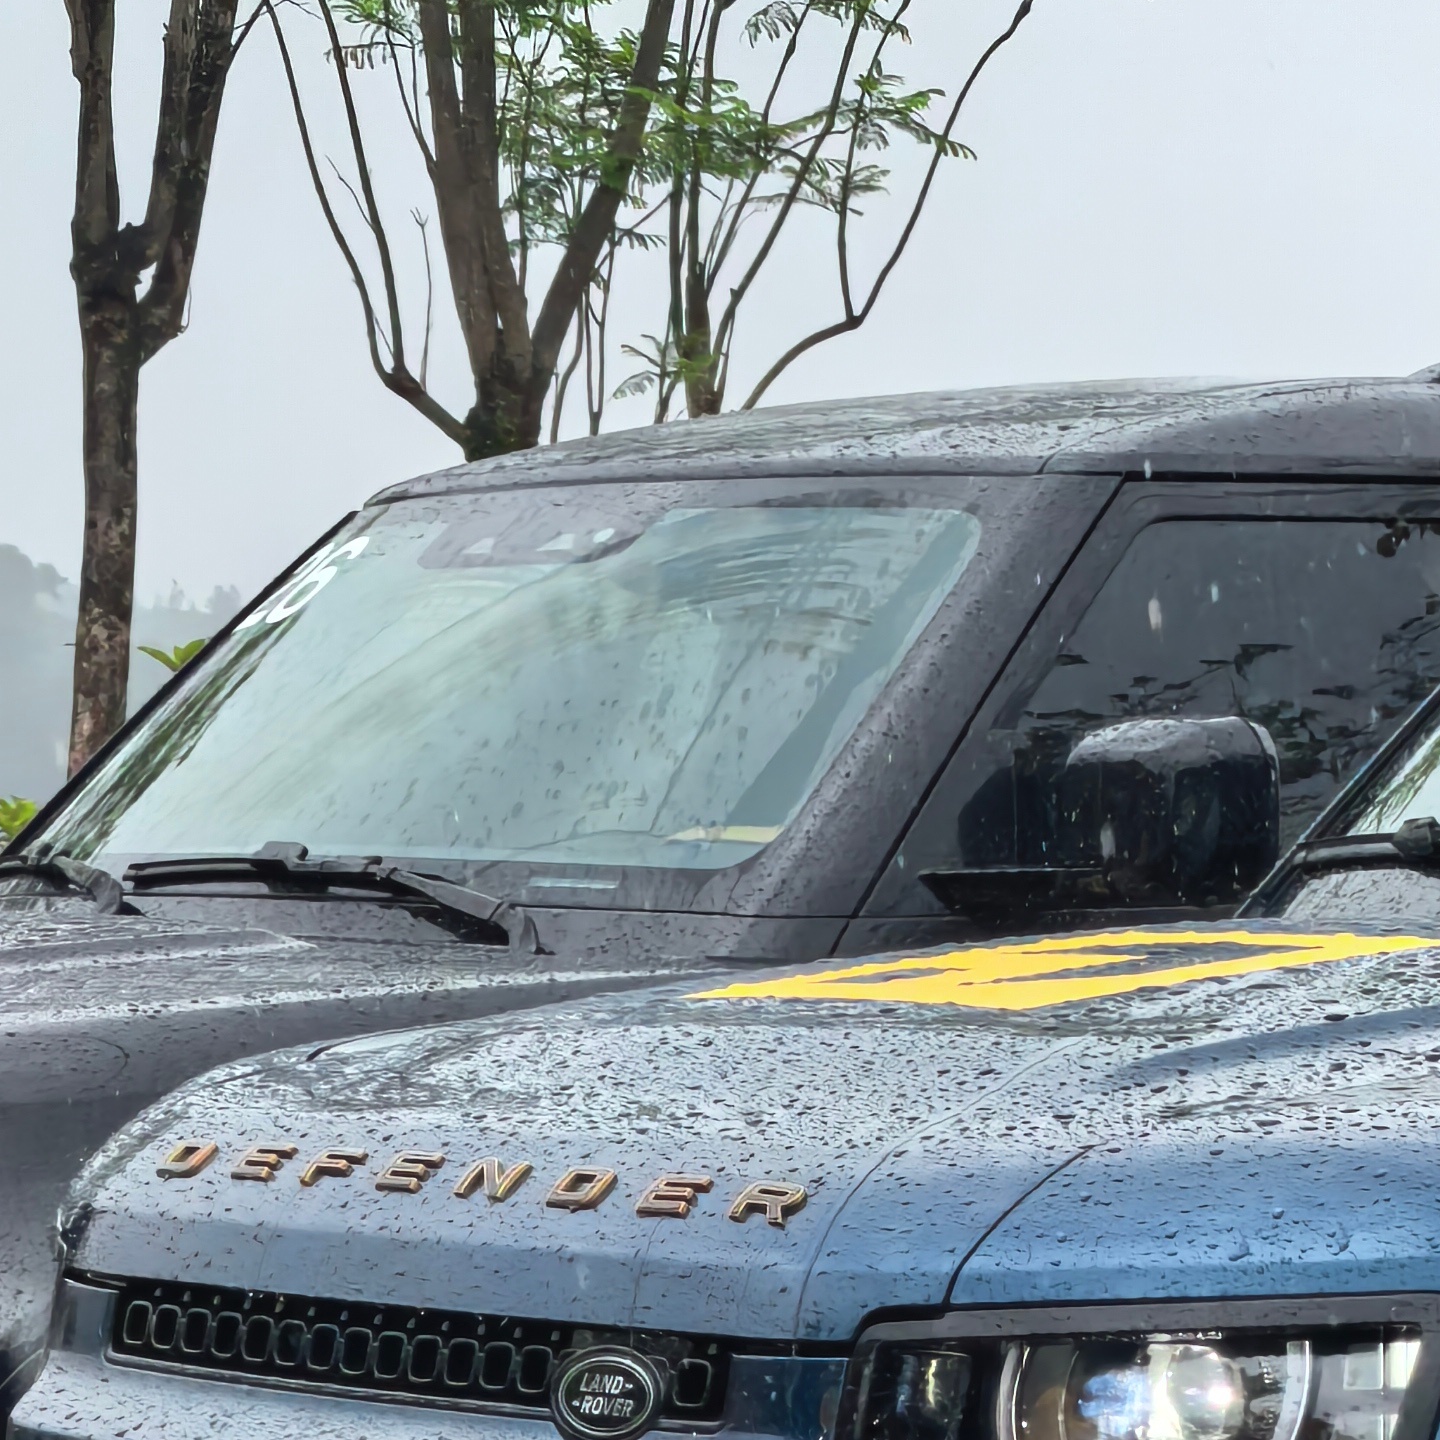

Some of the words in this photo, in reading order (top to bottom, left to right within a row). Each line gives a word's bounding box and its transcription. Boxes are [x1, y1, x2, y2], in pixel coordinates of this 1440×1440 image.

[231, 536, 370, 633] 26
[156, 1140, 809, 1229] DEFENDER
[579, 1372, 624, 1394] LAND
[580, 1395, 634, 1417] ROVER
